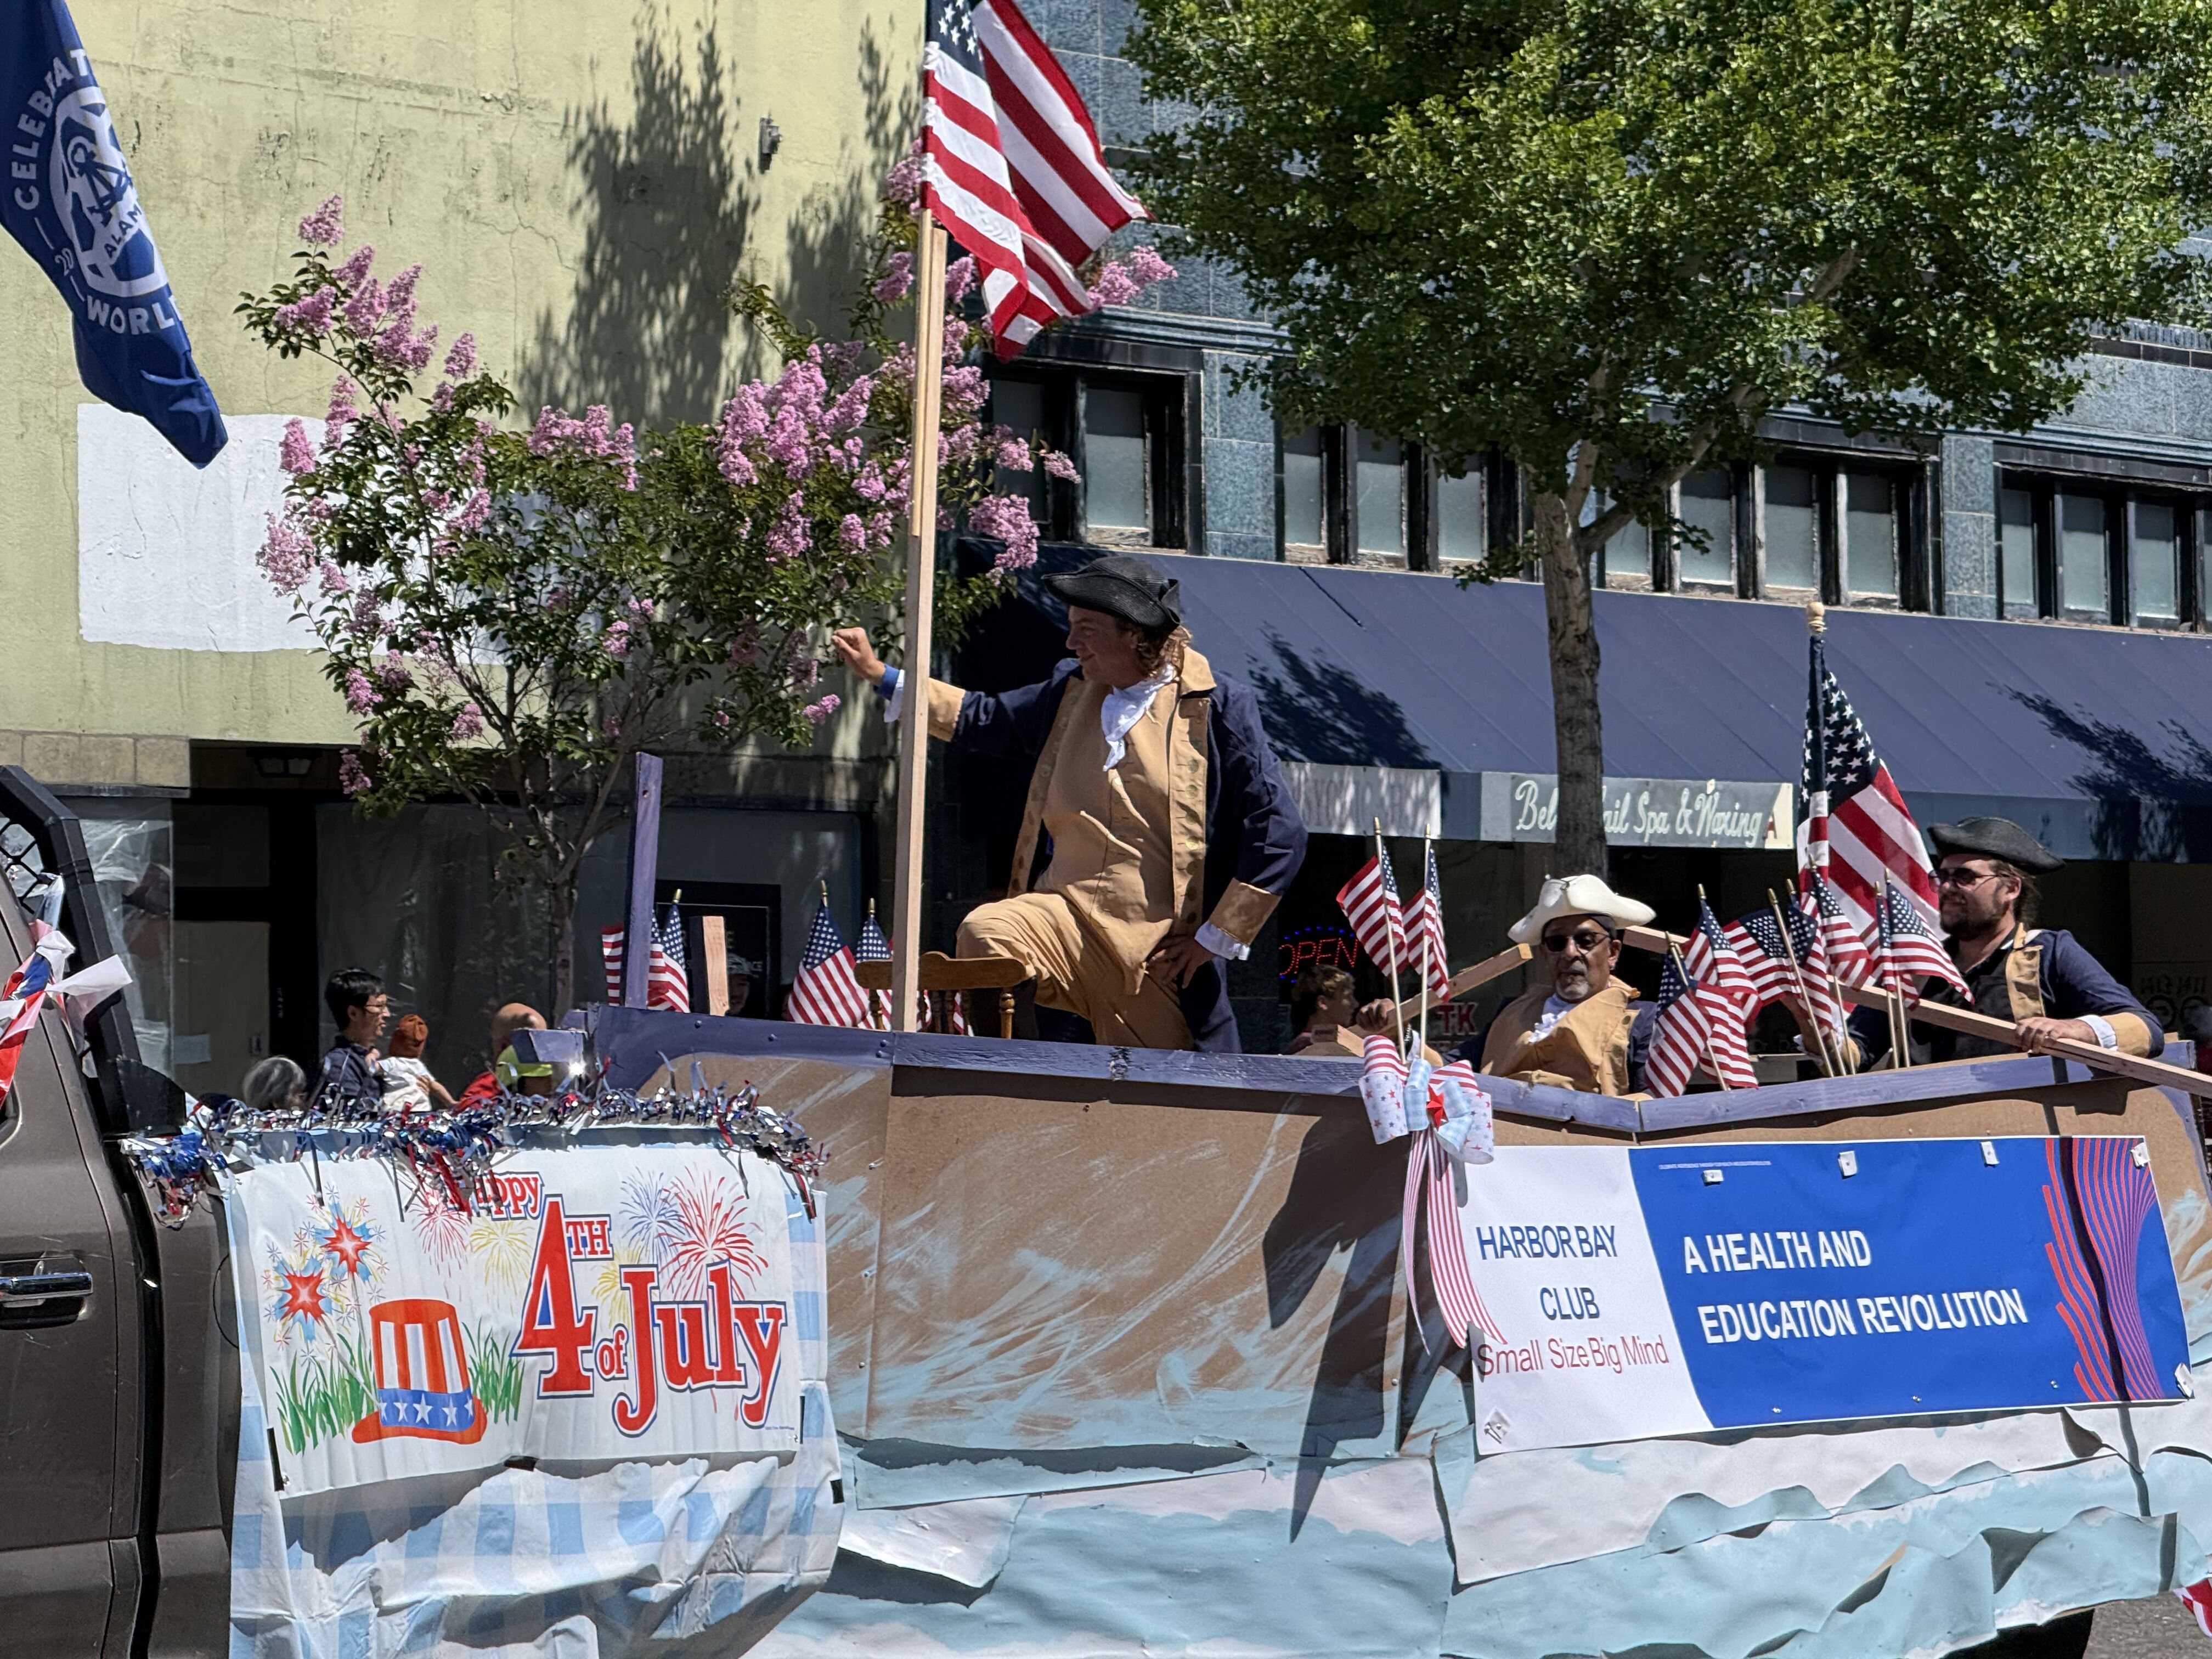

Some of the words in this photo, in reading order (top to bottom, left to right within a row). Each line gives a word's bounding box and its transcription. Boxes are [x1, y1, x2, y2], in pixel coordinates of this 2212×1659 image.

[1515, 780, 1559, 830] Bel
[1602, 785, 1630, 833] ail
[1633, 791, 1670, 843] Spa
[1675, 788, 1693, 834] &
[1695, 791, 1763, 848] Waxing
[1476, 1225, 1578, 1260] HARBOR
[1574, 1225, 1618, 1257] BAY
[1684, 1236, 1708, 1274] A
[1705, 1231, 1817, 1272] HEALTH
[1818, 1230, 1872, 1268] AND
[1539, 1287, 1600, 1321] CLUB
[1697, 1299, 1857, 1344] EDUCATION
[1857, 1288, 2029, 1335] REVOLUTION
[596, 1327, 627, 1380] of
[614, 1262, 785, 1435] July
[1477, 1339, 1544, 1376] Small
[1548, 1338, 1590, 1369] Size
[1587, 1337, 1623, 1374] Big
[1620, 1334, 1669, 1365] Mind
